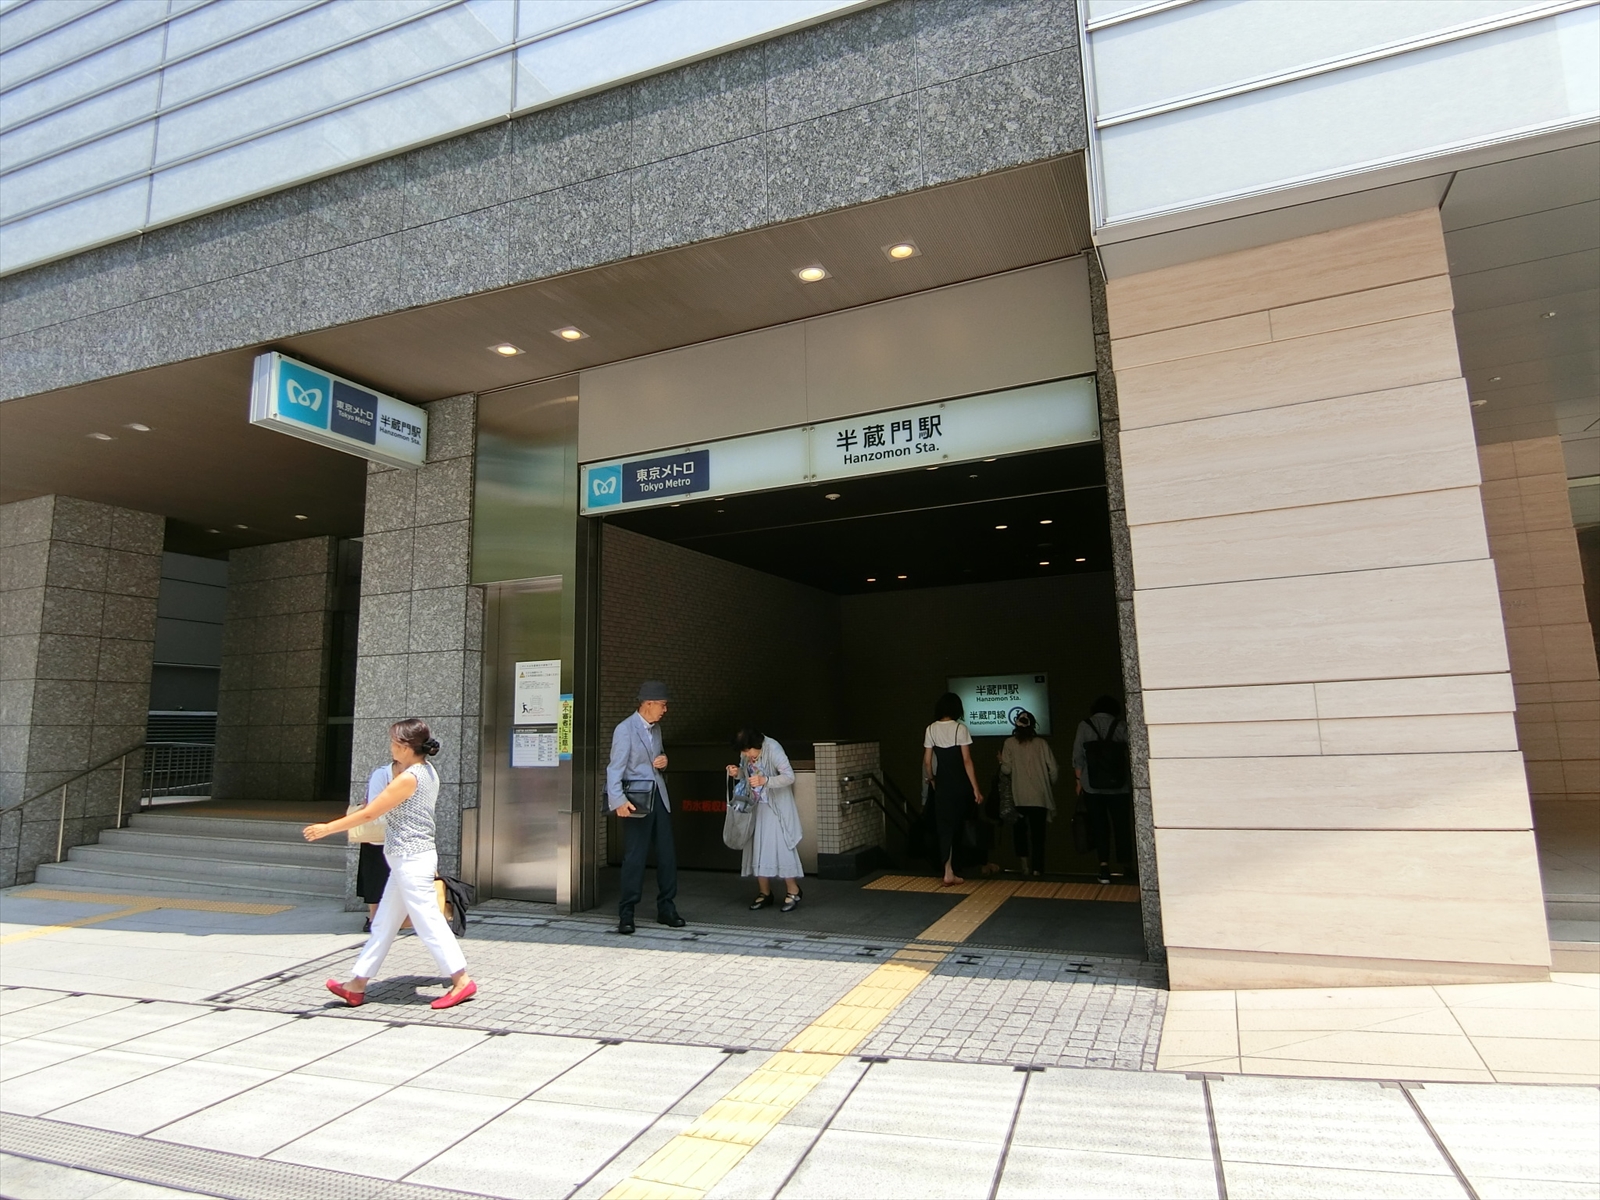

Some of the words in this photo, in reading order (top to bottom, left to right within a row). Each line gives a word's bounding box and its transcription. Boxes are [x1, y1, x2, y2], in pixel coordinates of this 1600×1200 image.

[336, 400, 374, 420] 東京メトロ
[338, 410, 354, 421] Tokyo
[355, 415, 371, 426] Metro
[379, 426, 410, 441] Hanzomon
[411, 436, 422, 446] Sta.
[380, 414, 422, 439] 半蔵門駅
[836, 414, 942, 452] 半蔵門駅
[843, 446, 911, 465] Hanzomon
[915, 442, 940, 454] Sta.
[636, 461, 694, 482] 東京メトロ
[639, 481, 664, 493] Tokyo
[665, 478, 691, 489] Metro
[976, 684, 1019, 696] 半蔵門駅
[970, 710, 1006, 720] 半蔵門線
